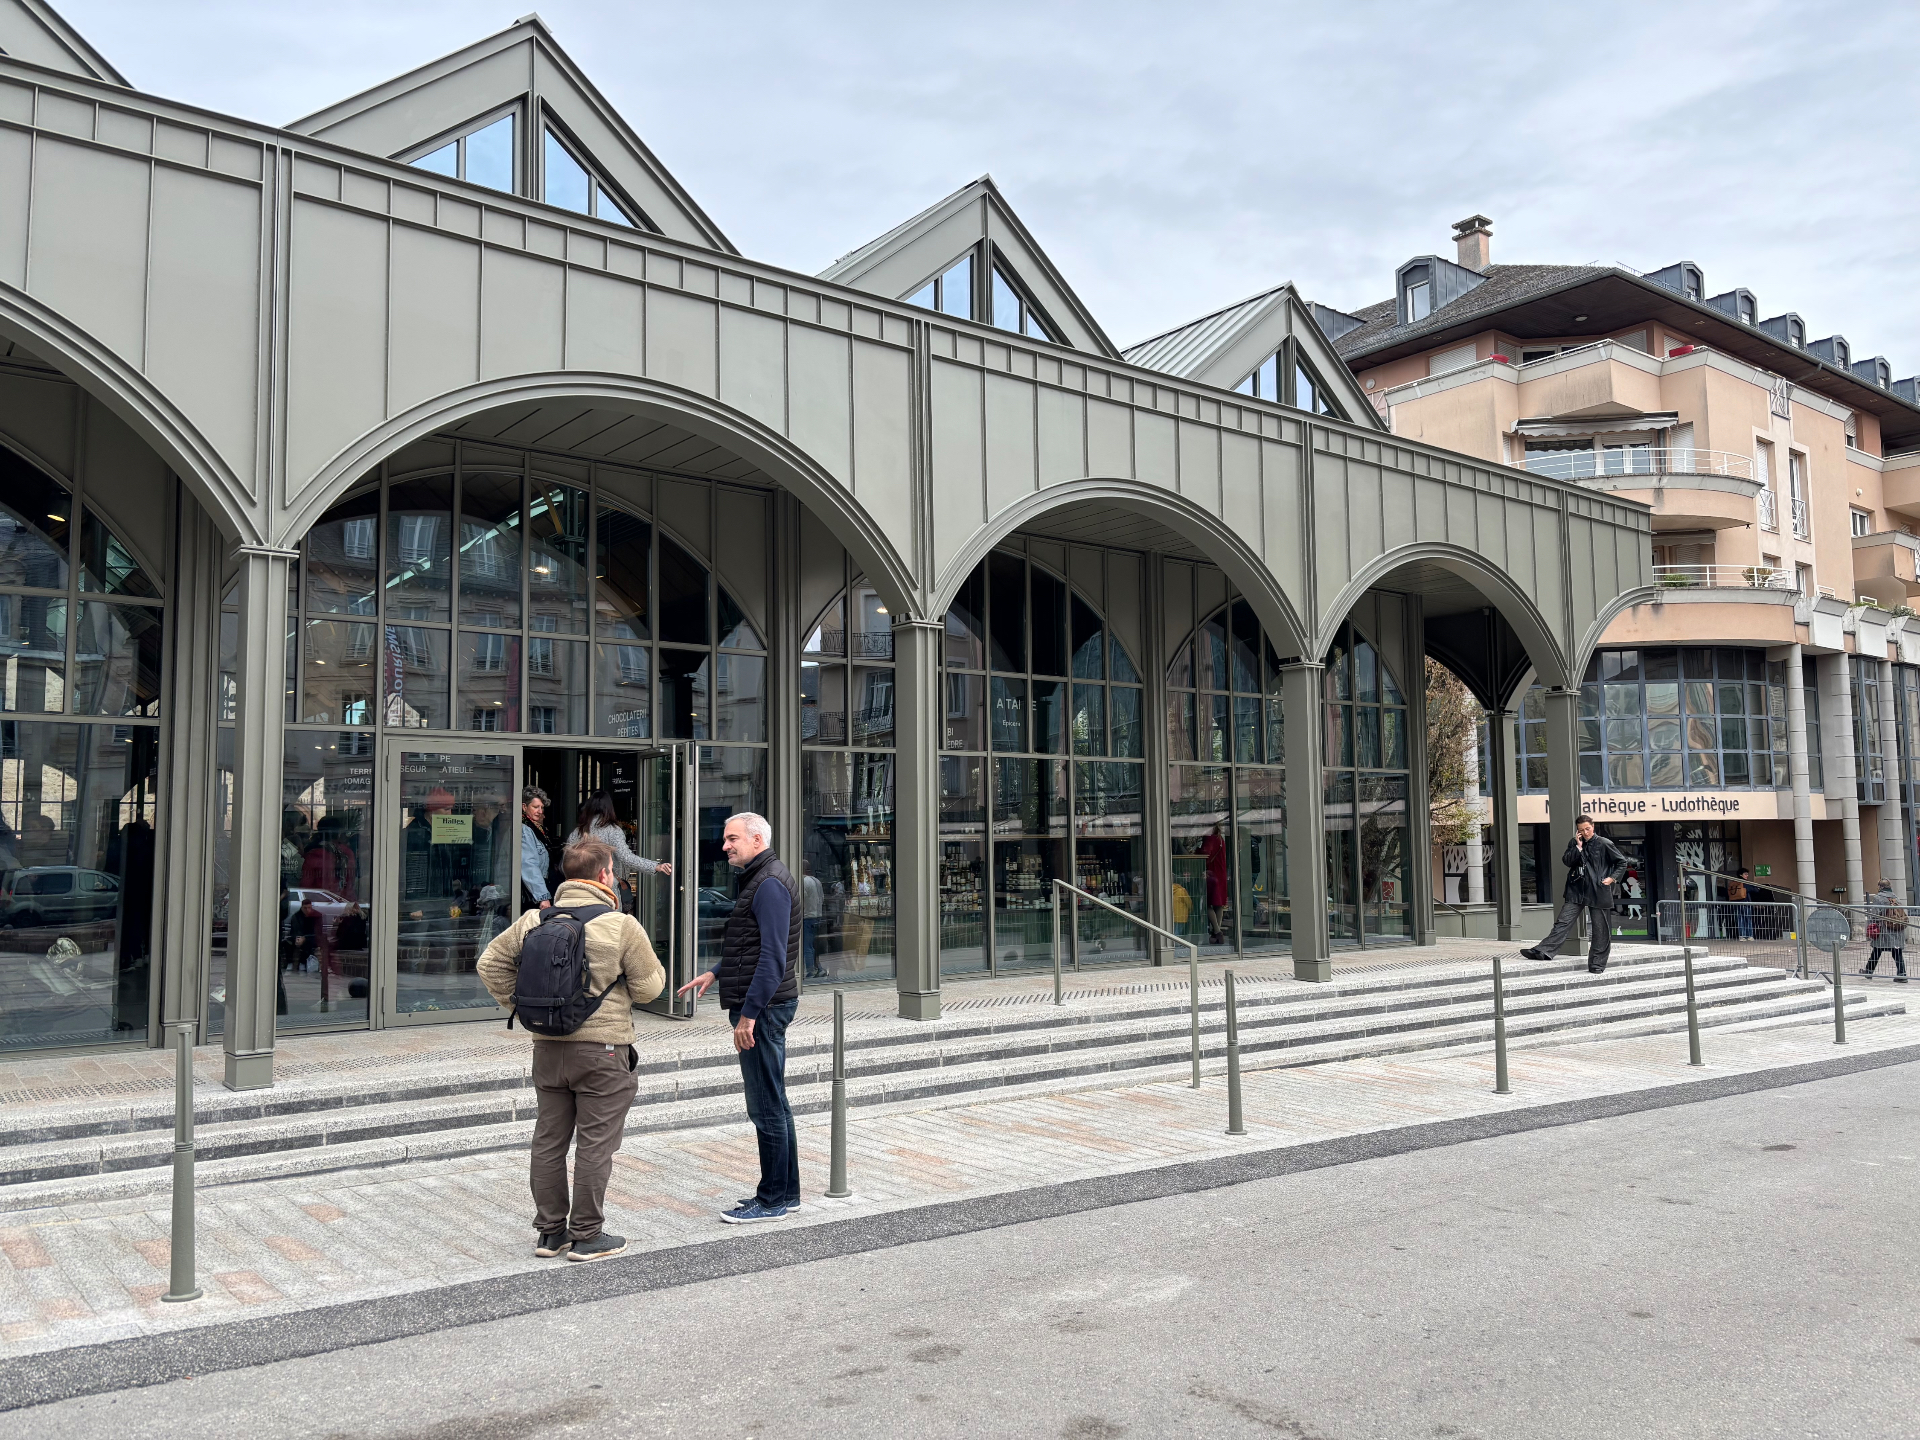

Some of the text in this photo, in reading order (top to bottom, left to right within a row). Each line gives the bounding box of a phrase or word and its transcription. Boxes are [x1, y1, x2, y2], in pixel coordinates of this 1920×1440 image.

[996, 698, 1004, 709] A
[439, 766, 474, 774] ATIEULE
[1545, 798, 1646, 818] athèque
[1662, 796, 1740, 816] Ludothèque
